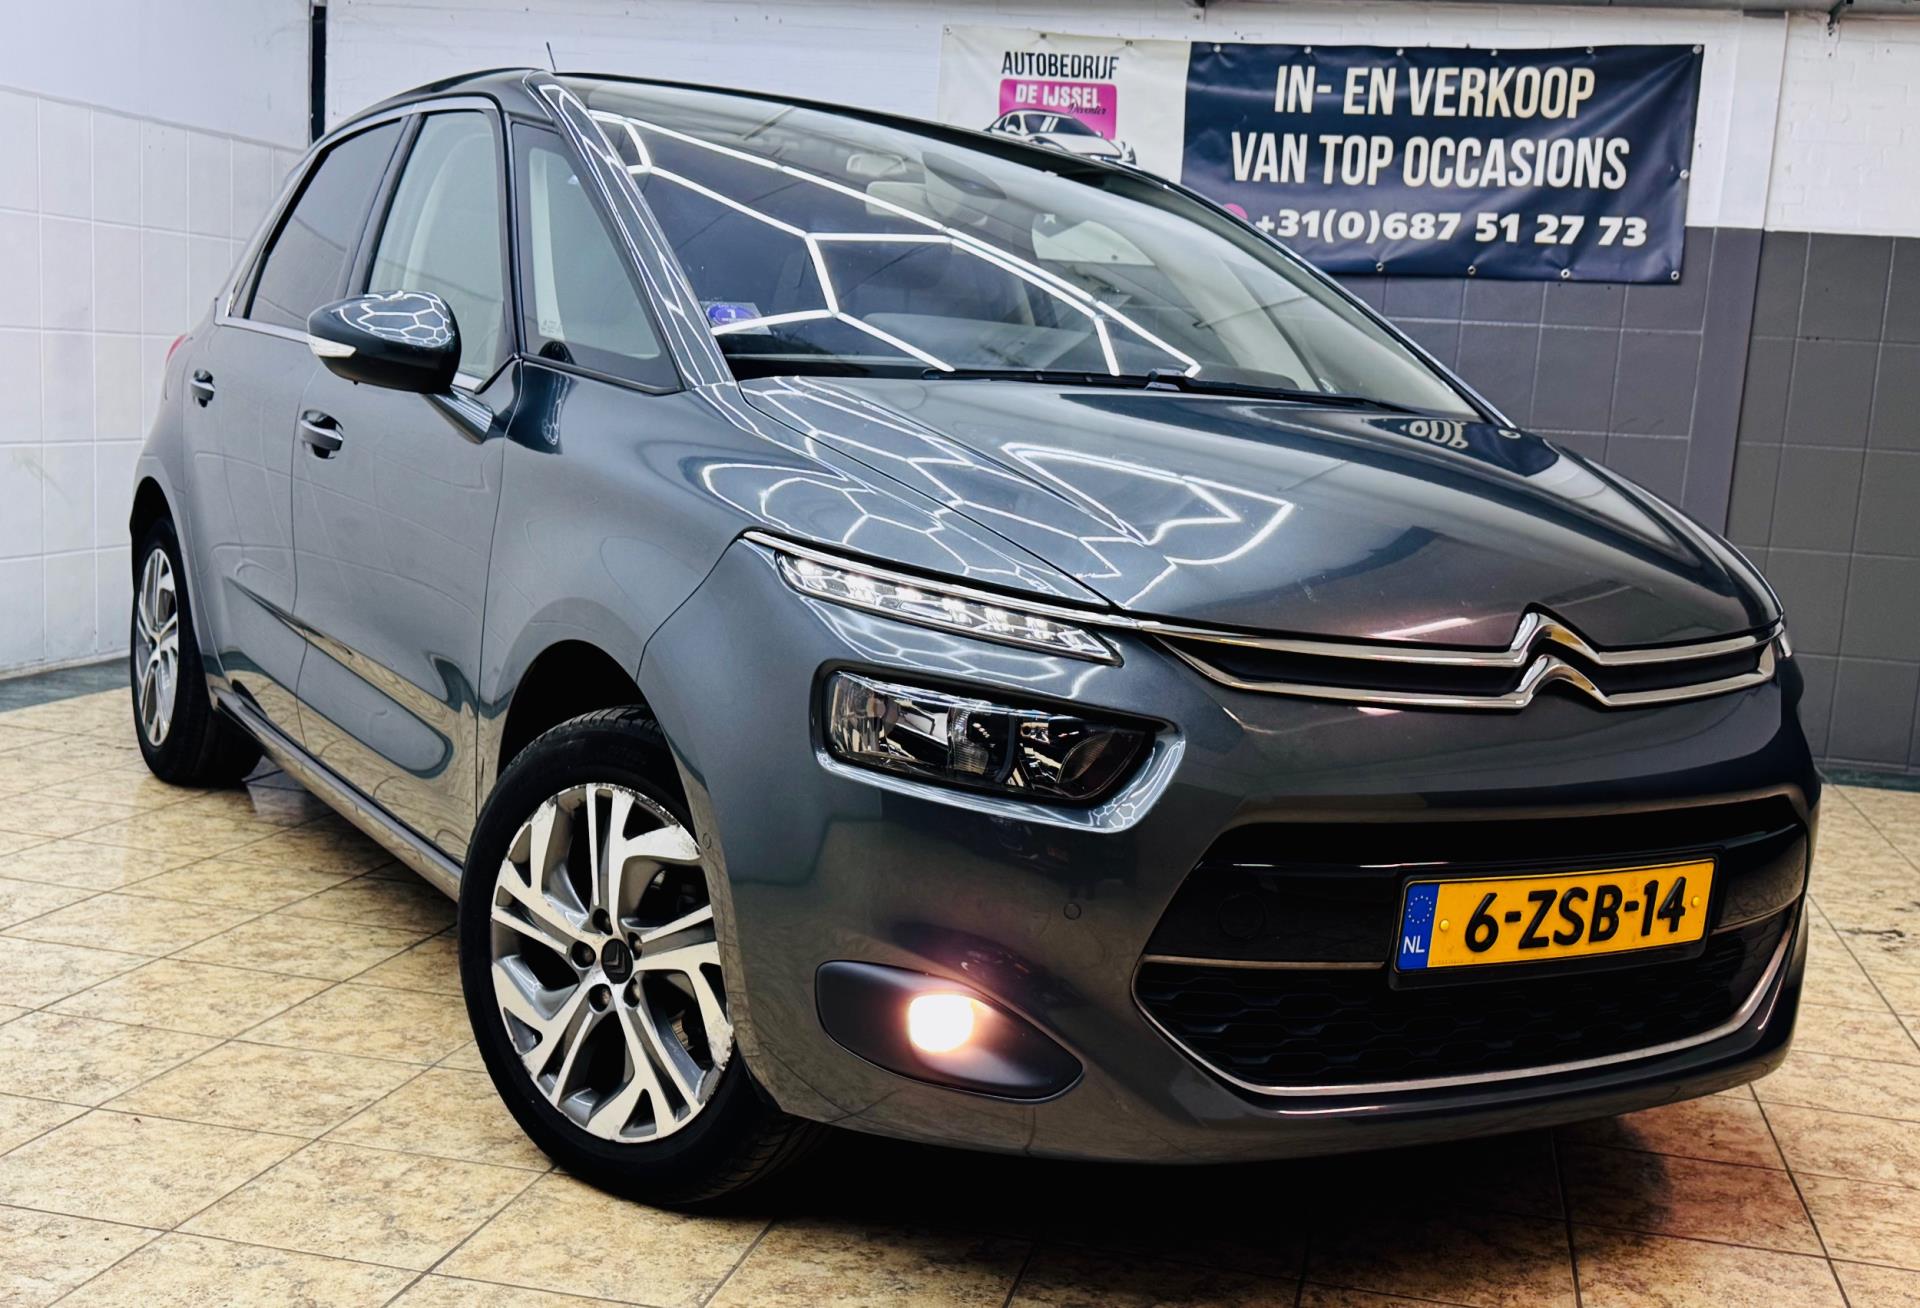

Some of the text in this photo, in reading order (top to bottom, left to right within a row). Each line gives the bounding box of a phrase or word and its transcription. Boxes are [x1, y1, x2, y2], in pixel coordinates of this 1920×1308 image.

[1001, 51, 1119, 79] AUTOBEDRIJF
[1015, 83, 1038, 104] DE
[1275, 65, 1596, 119] IN- EN VERKOOP
[1231, 131, 1631, 190] VAN TOP OCCASIONS
[1255, 208, 1648, 247] +31(0)687 51 27 73
[1464, 877, 1686, 953] 6-ZSB-14
[1402, 935, 1426, 955] NL
